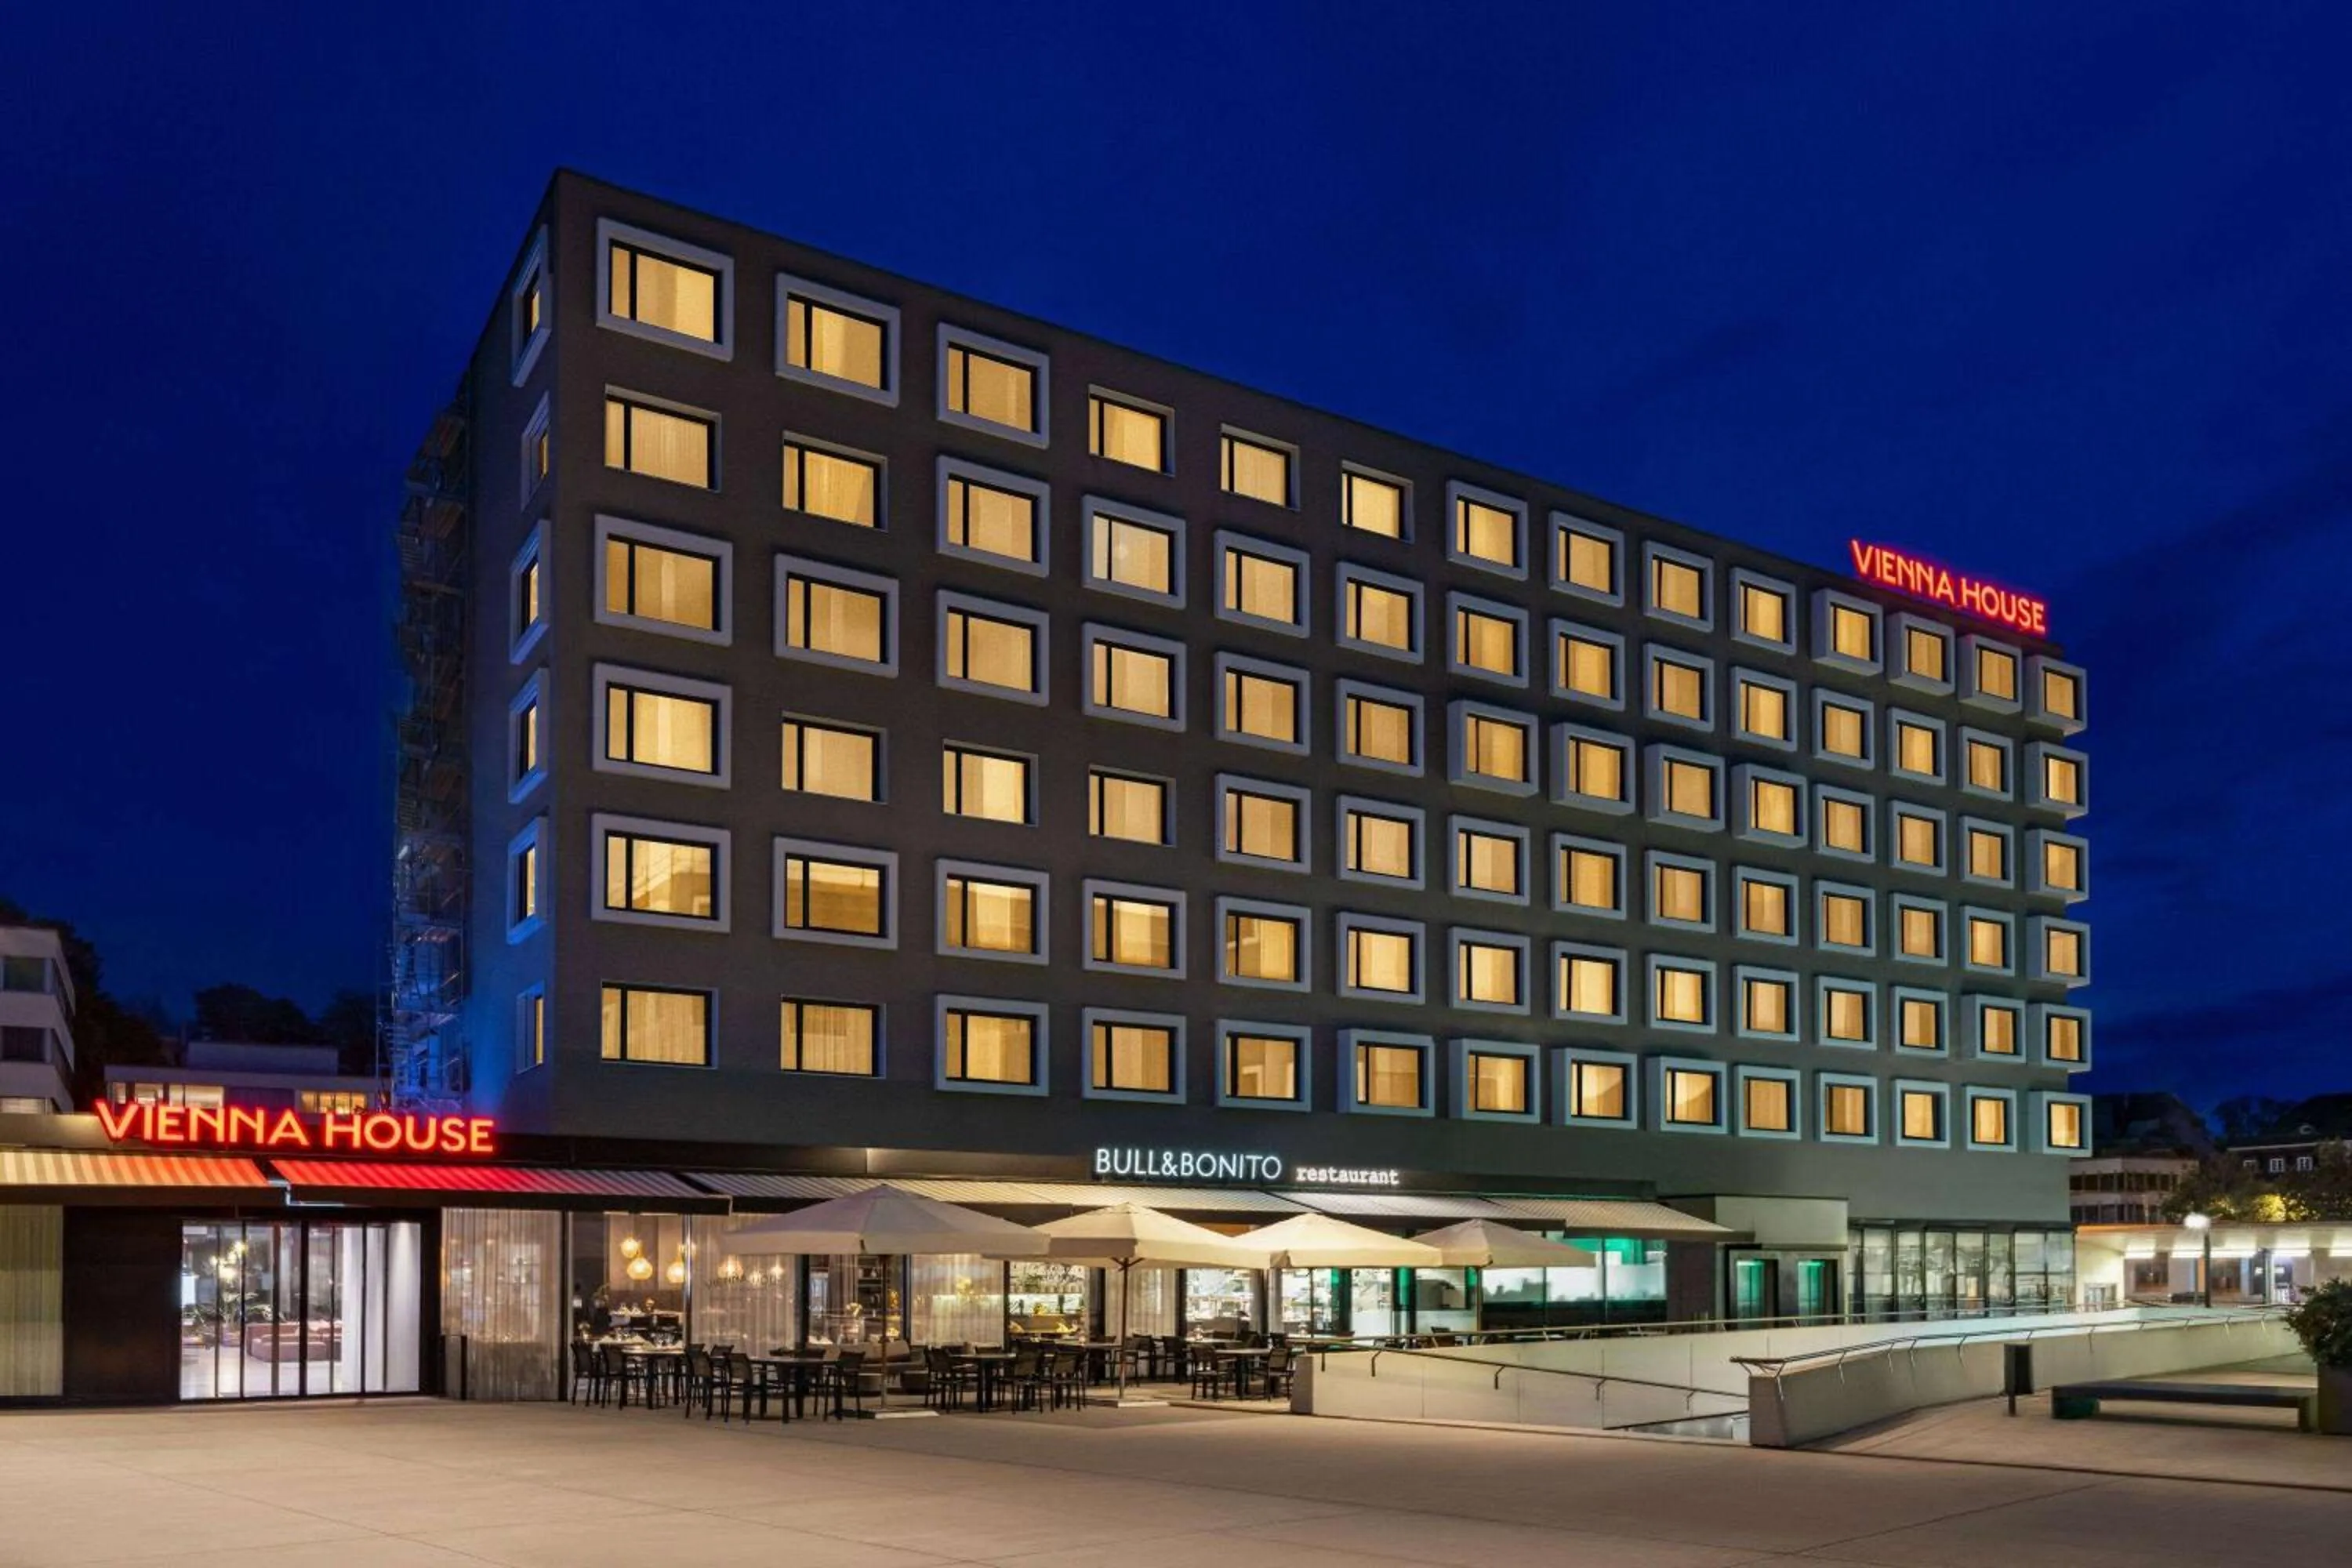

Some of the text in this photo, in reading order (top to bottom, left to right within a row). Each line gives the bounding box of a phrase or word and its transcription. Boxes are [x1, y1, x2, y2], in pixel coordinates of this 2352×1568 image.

[1851, 539, 2045, 633] VIENNA HOUSE
[95, 1101, 495, 1152] VIENNA HOUSE
[1096, 1148, 1399, 1185] BULL&BONITO restaurant
